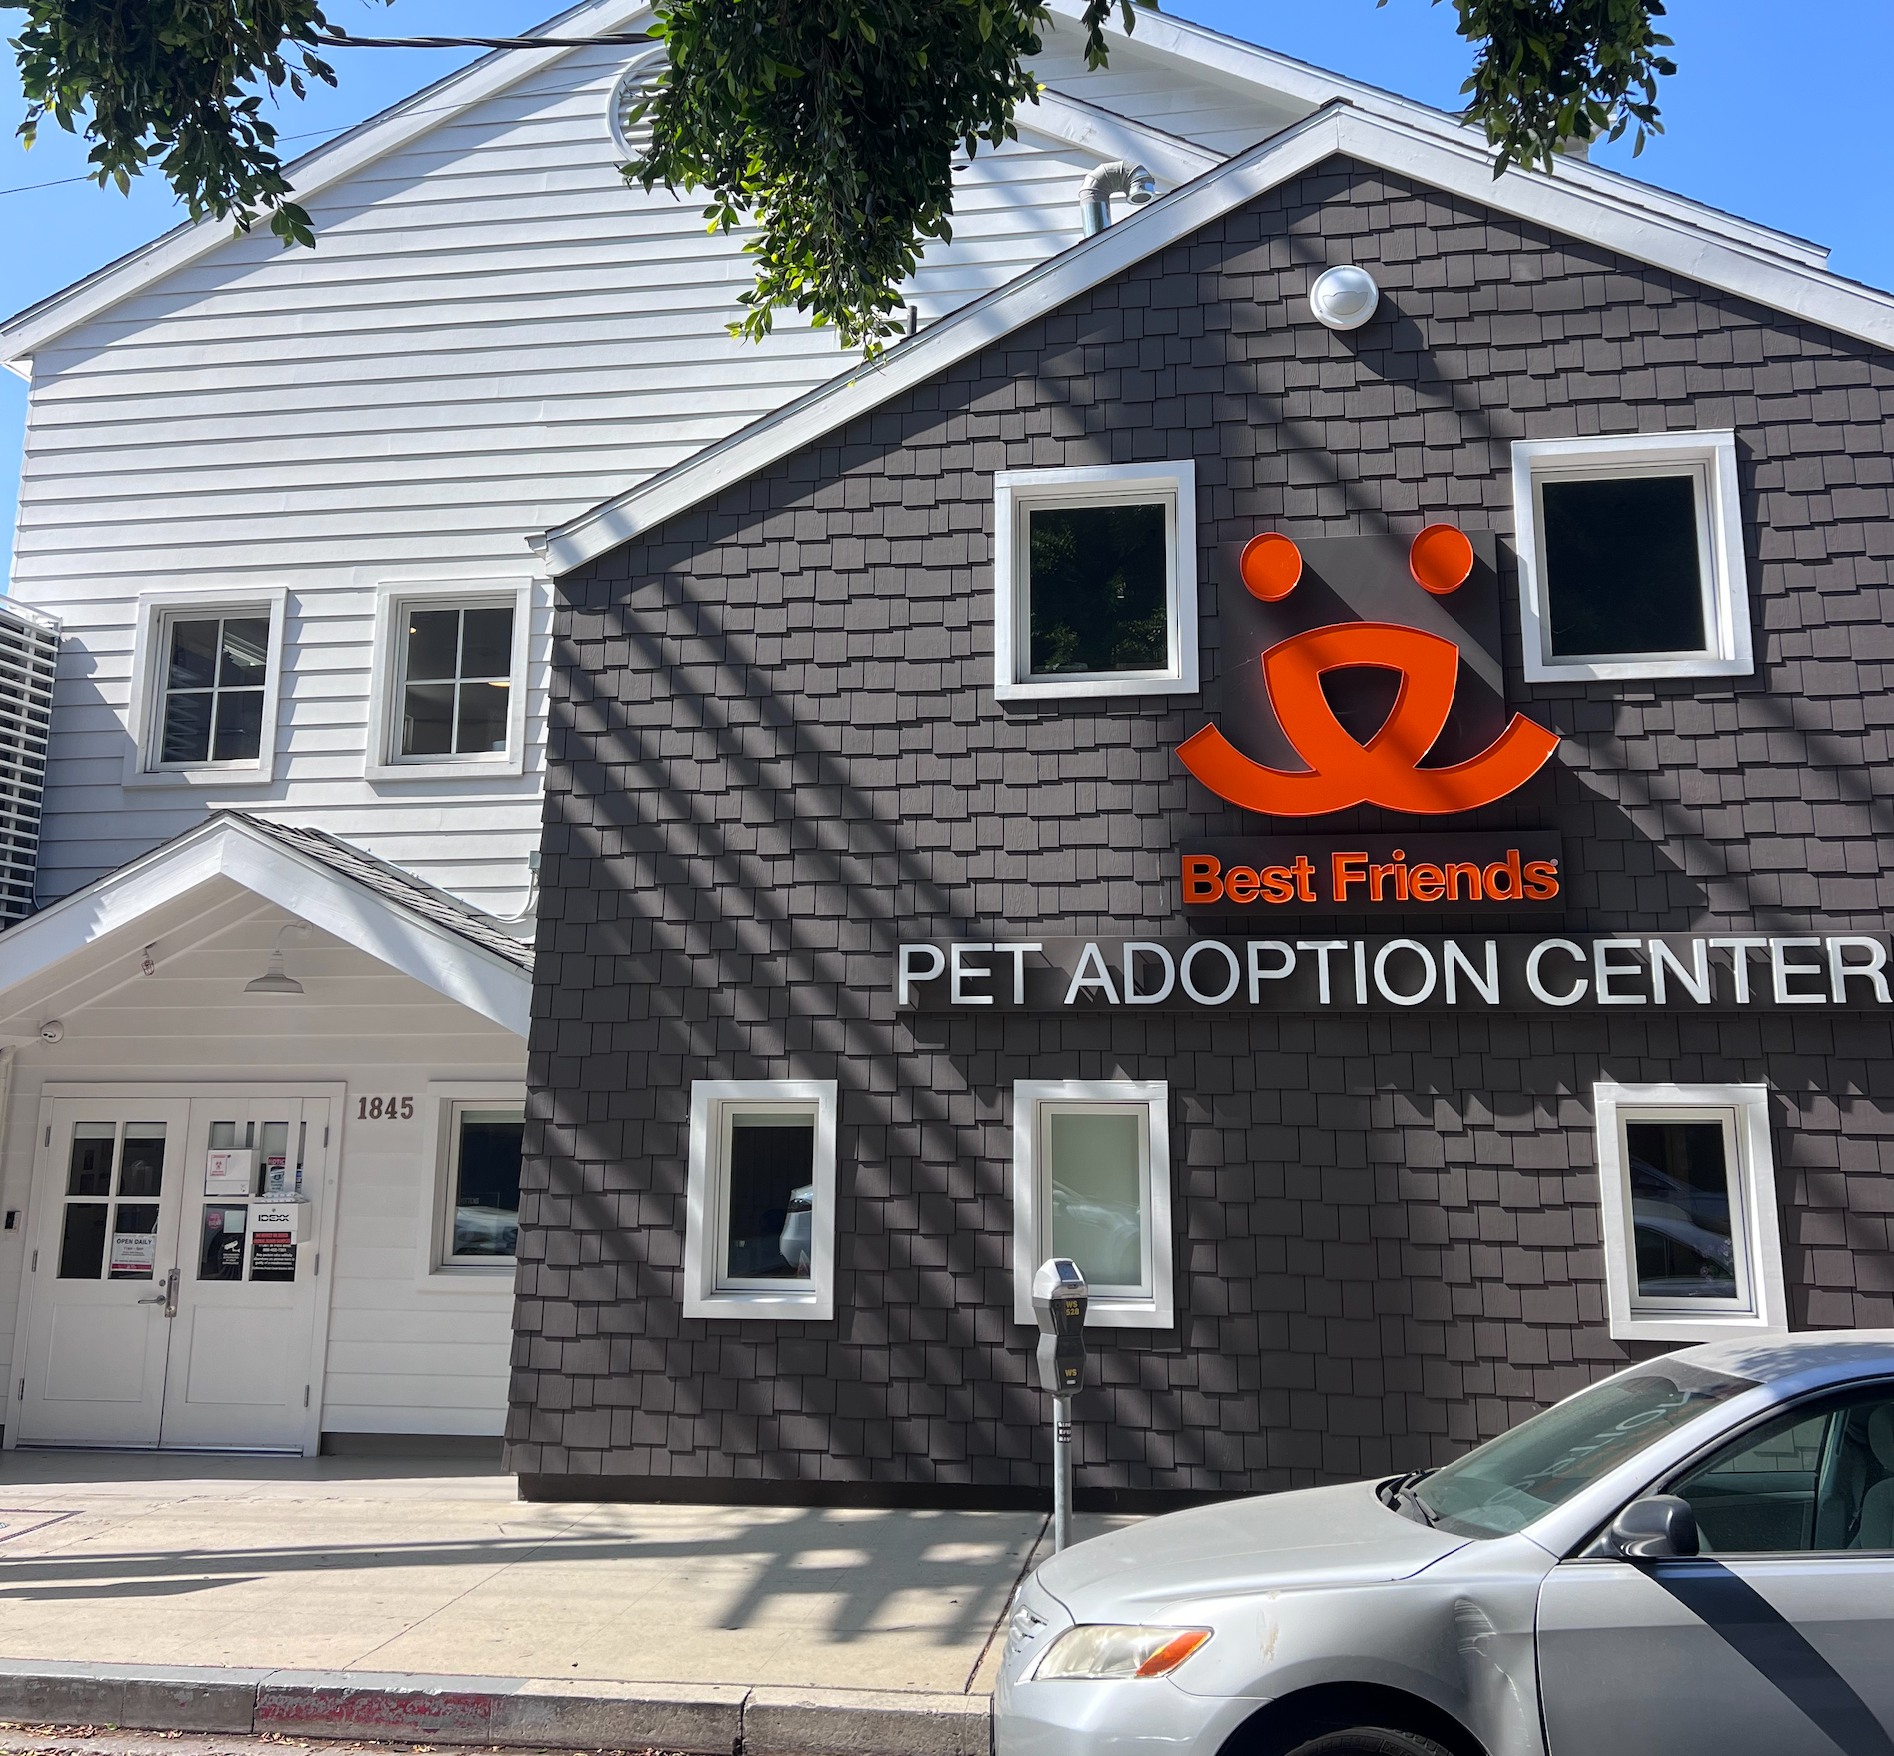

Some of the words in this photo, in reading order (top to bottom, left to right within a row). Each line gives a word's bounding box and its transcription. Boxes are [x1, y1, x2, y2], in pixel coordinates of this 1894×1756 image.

[1181, 854, 1317, 904] Best
[1331, 848, 1560, 902] Friends
[898, 942, 1043, 1005] PET
[1063, 938, 1500, 1006] ADOPTION
[1525, 936, 1894, 1006] CENTER
[357, 1096, 414, 1120] 1845
[258, 1214, 290, 1222] IDEXX
[134, 1238, 153, 1246] DAILY
[1066, 1301, 1078, 1309] WS
[1066, 1308, 1080, 1316] 528
[1065, 1369, 1078, 1377] WS
